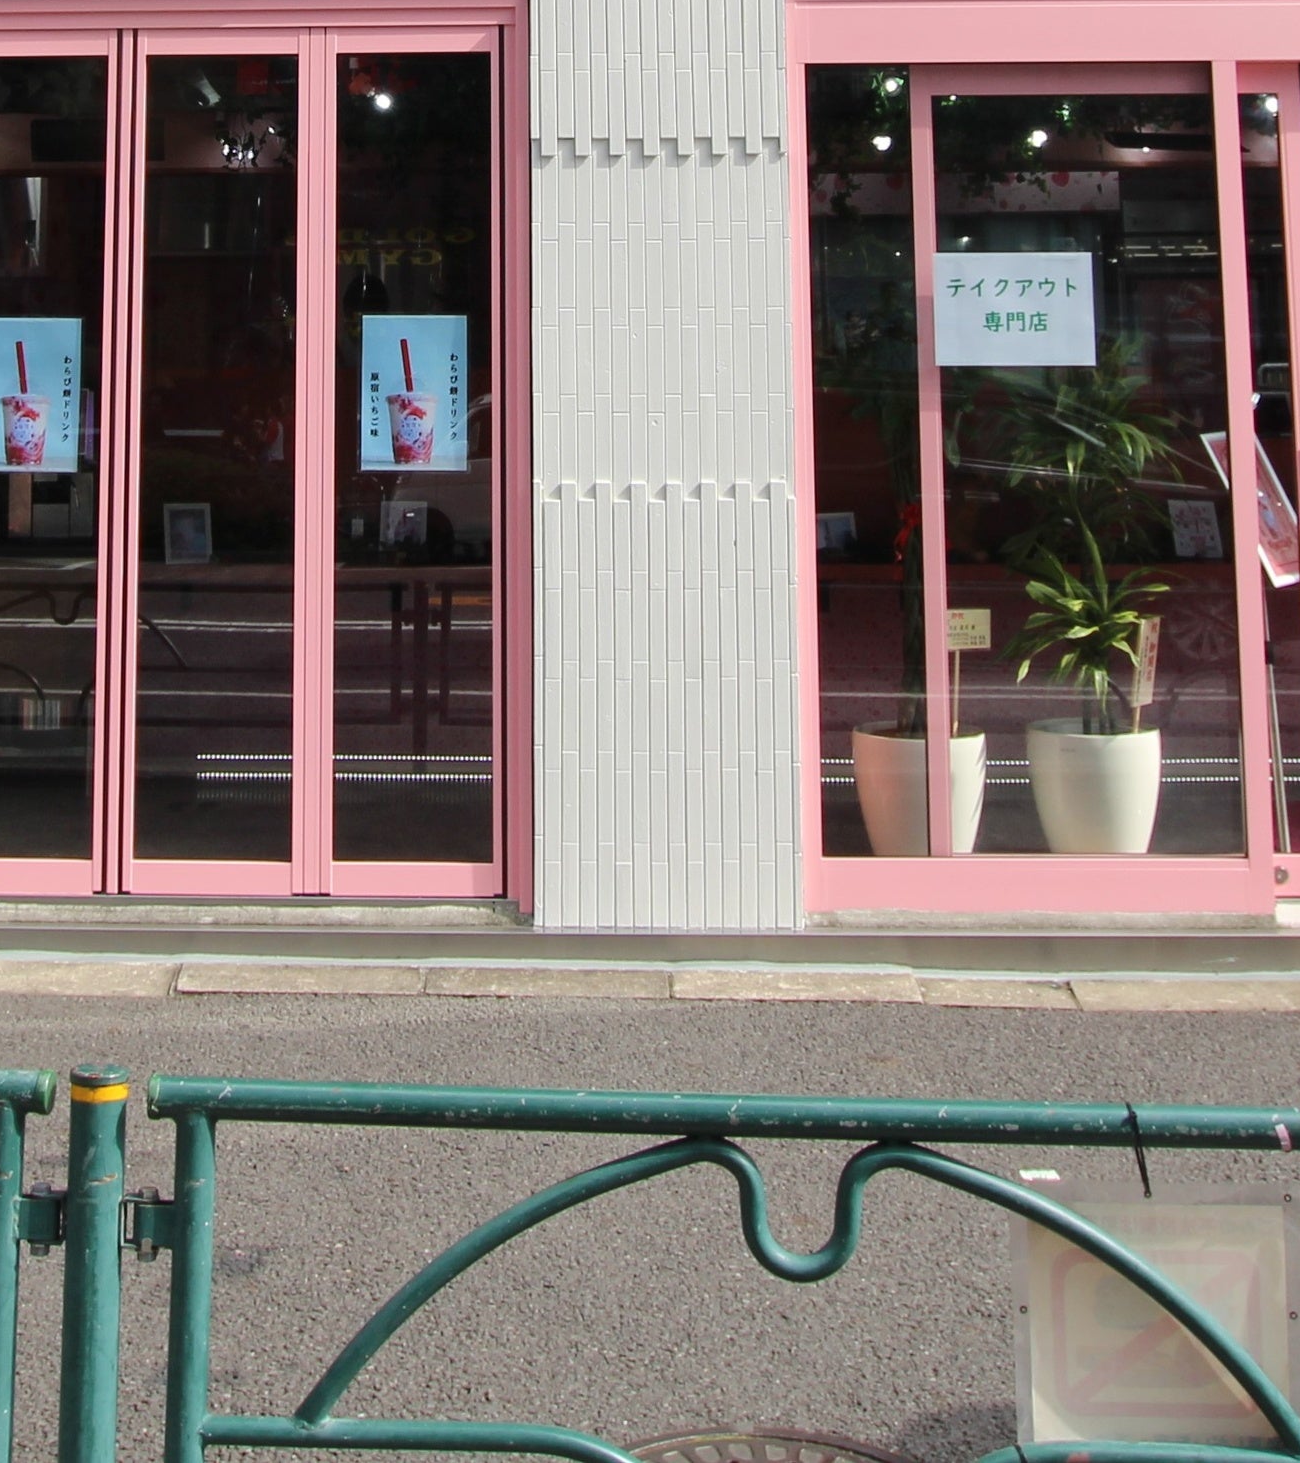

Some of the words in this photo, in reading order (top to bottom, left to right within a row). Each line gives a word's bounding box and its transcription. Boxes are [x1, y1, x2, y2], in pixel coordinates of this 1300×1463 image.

[946, 277, 1078, 298] テイクアウト
[982, 311, 1049, 333] 専門店
